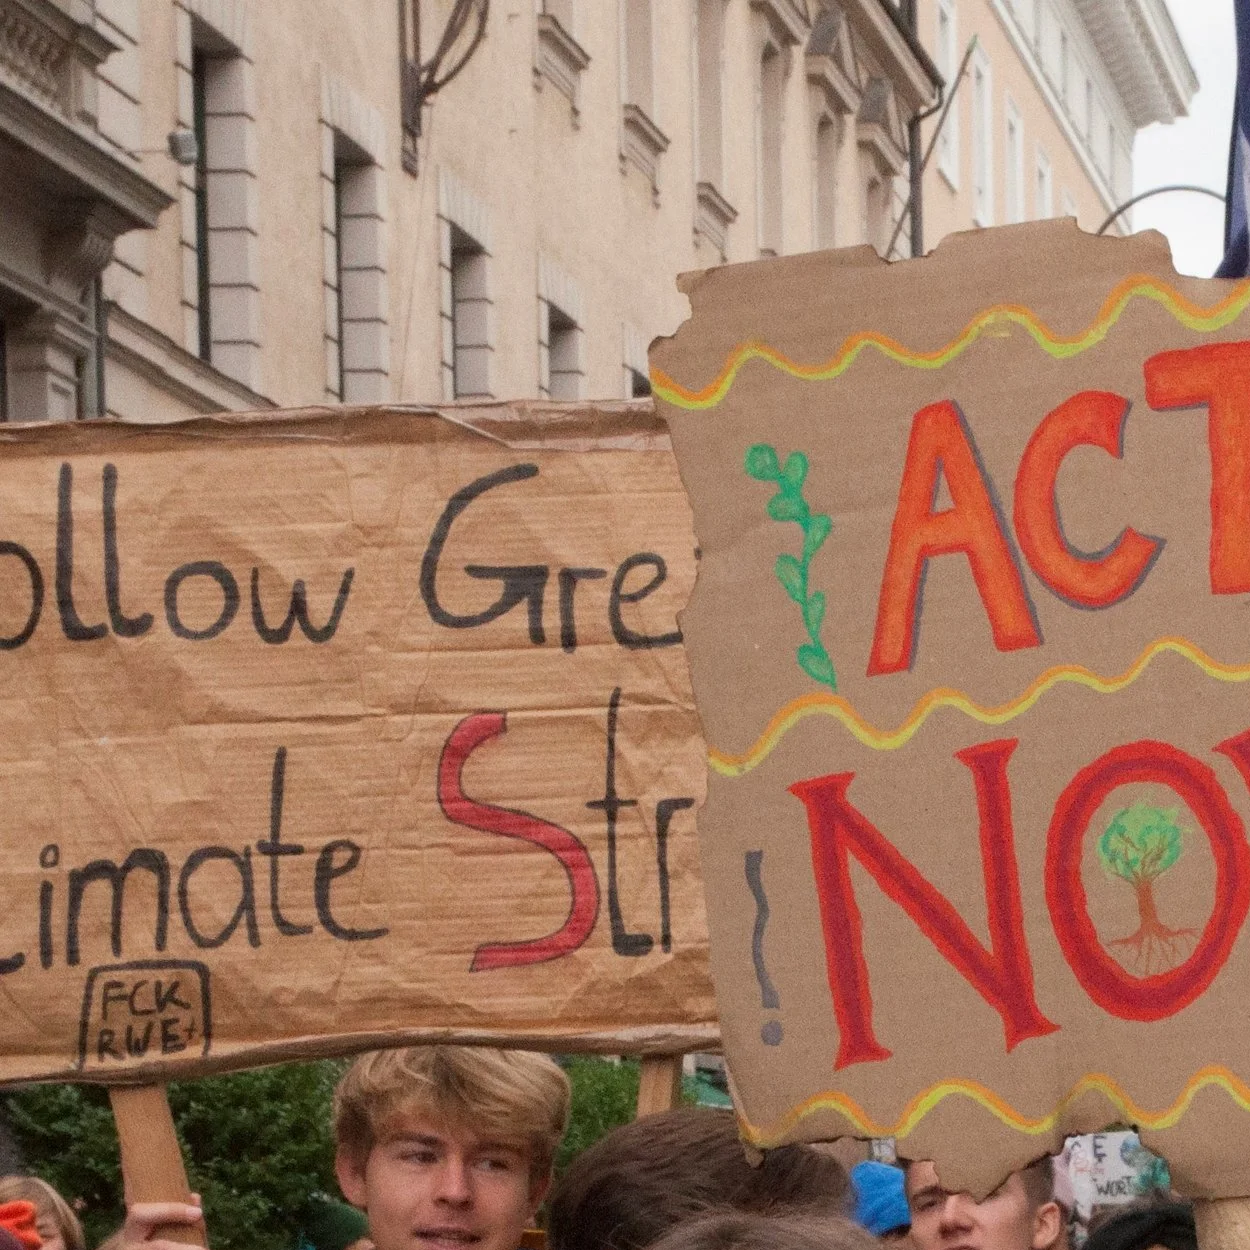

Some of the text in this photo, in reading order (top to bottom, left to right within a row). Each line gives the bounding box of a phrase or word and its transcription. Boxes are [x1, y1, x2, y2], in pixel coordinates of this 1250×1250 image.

[420, 464, 683, 652] Gre
[437, 687, 694, 973] Str
[102, 979, 191, 1020] FCK
